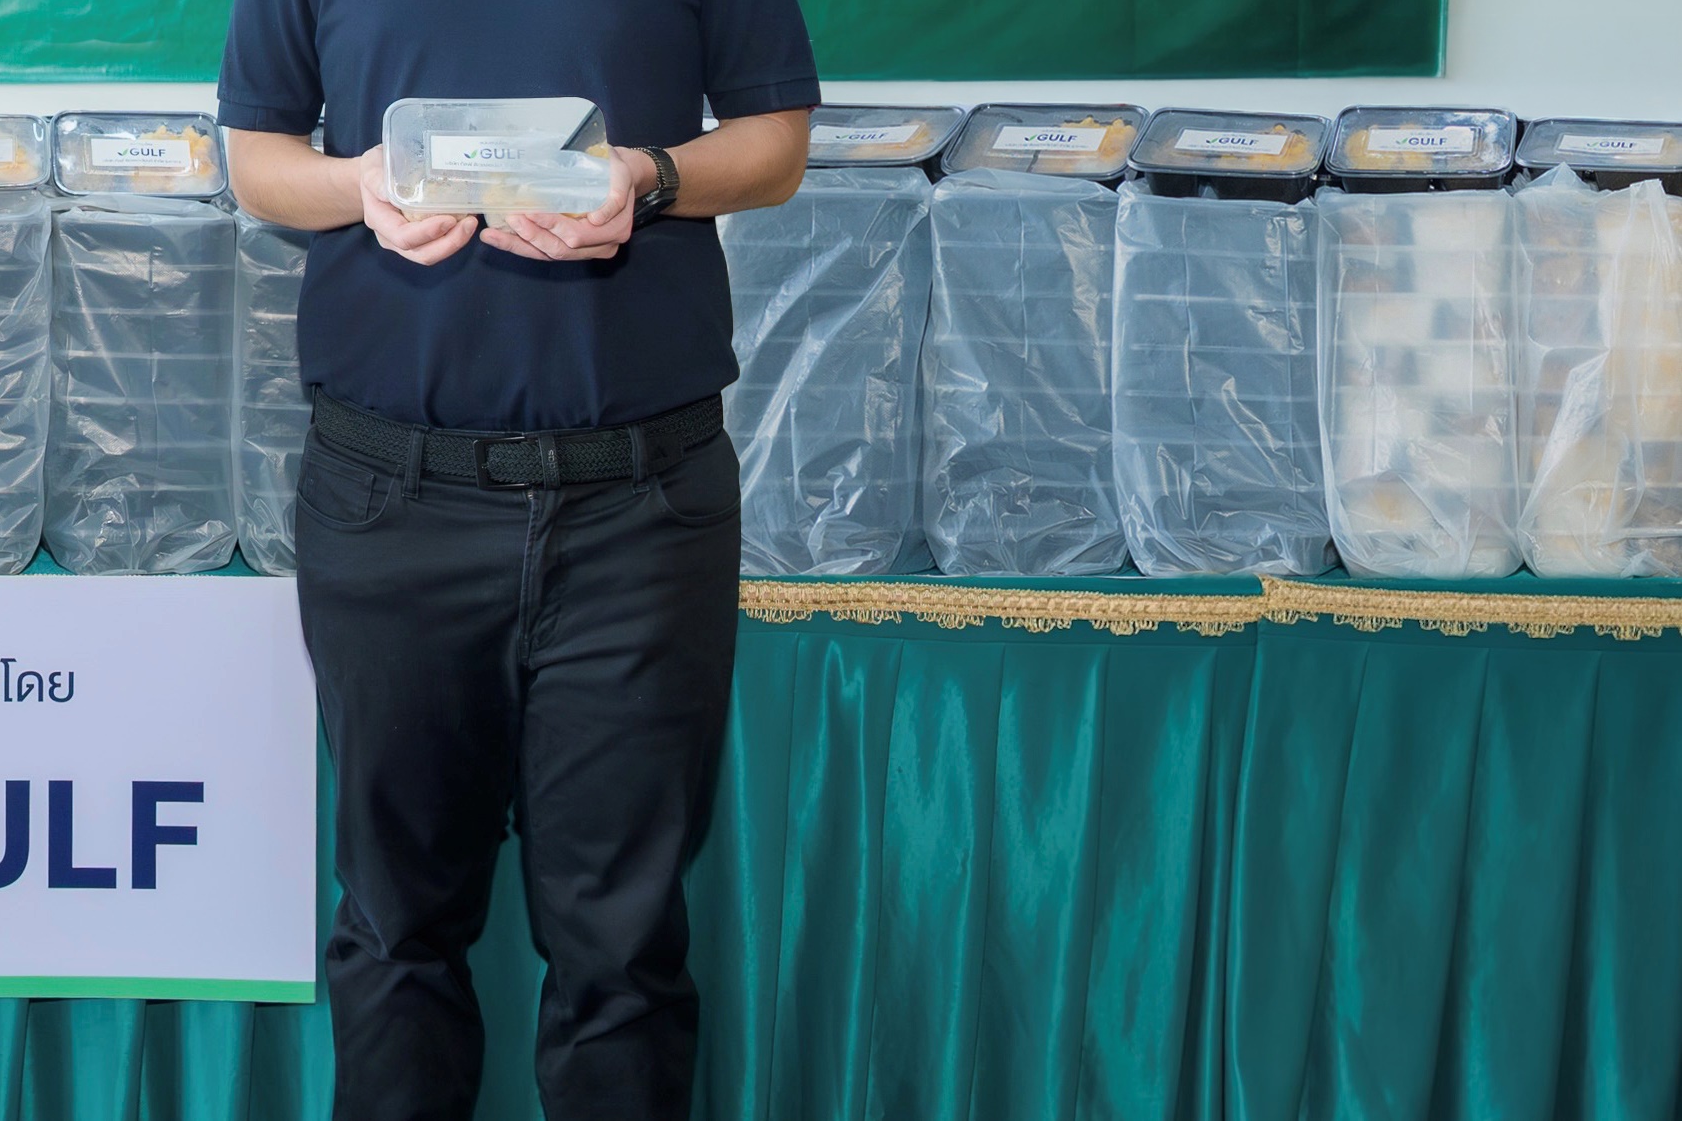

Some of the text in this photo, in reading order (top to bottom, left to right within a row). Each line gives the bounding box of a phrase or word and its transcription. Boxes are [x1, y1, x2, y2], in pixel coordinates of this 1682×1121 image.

[848, 132, 889, 141] GULF
[1036, 133, 1077, 143] GULF
[1218, 137, 1259, 146] GULF
[1408, 137, 1448, 146] GULF
[129, 148, 166, 157] GULF
[480, 148, 525, 159] GULF
